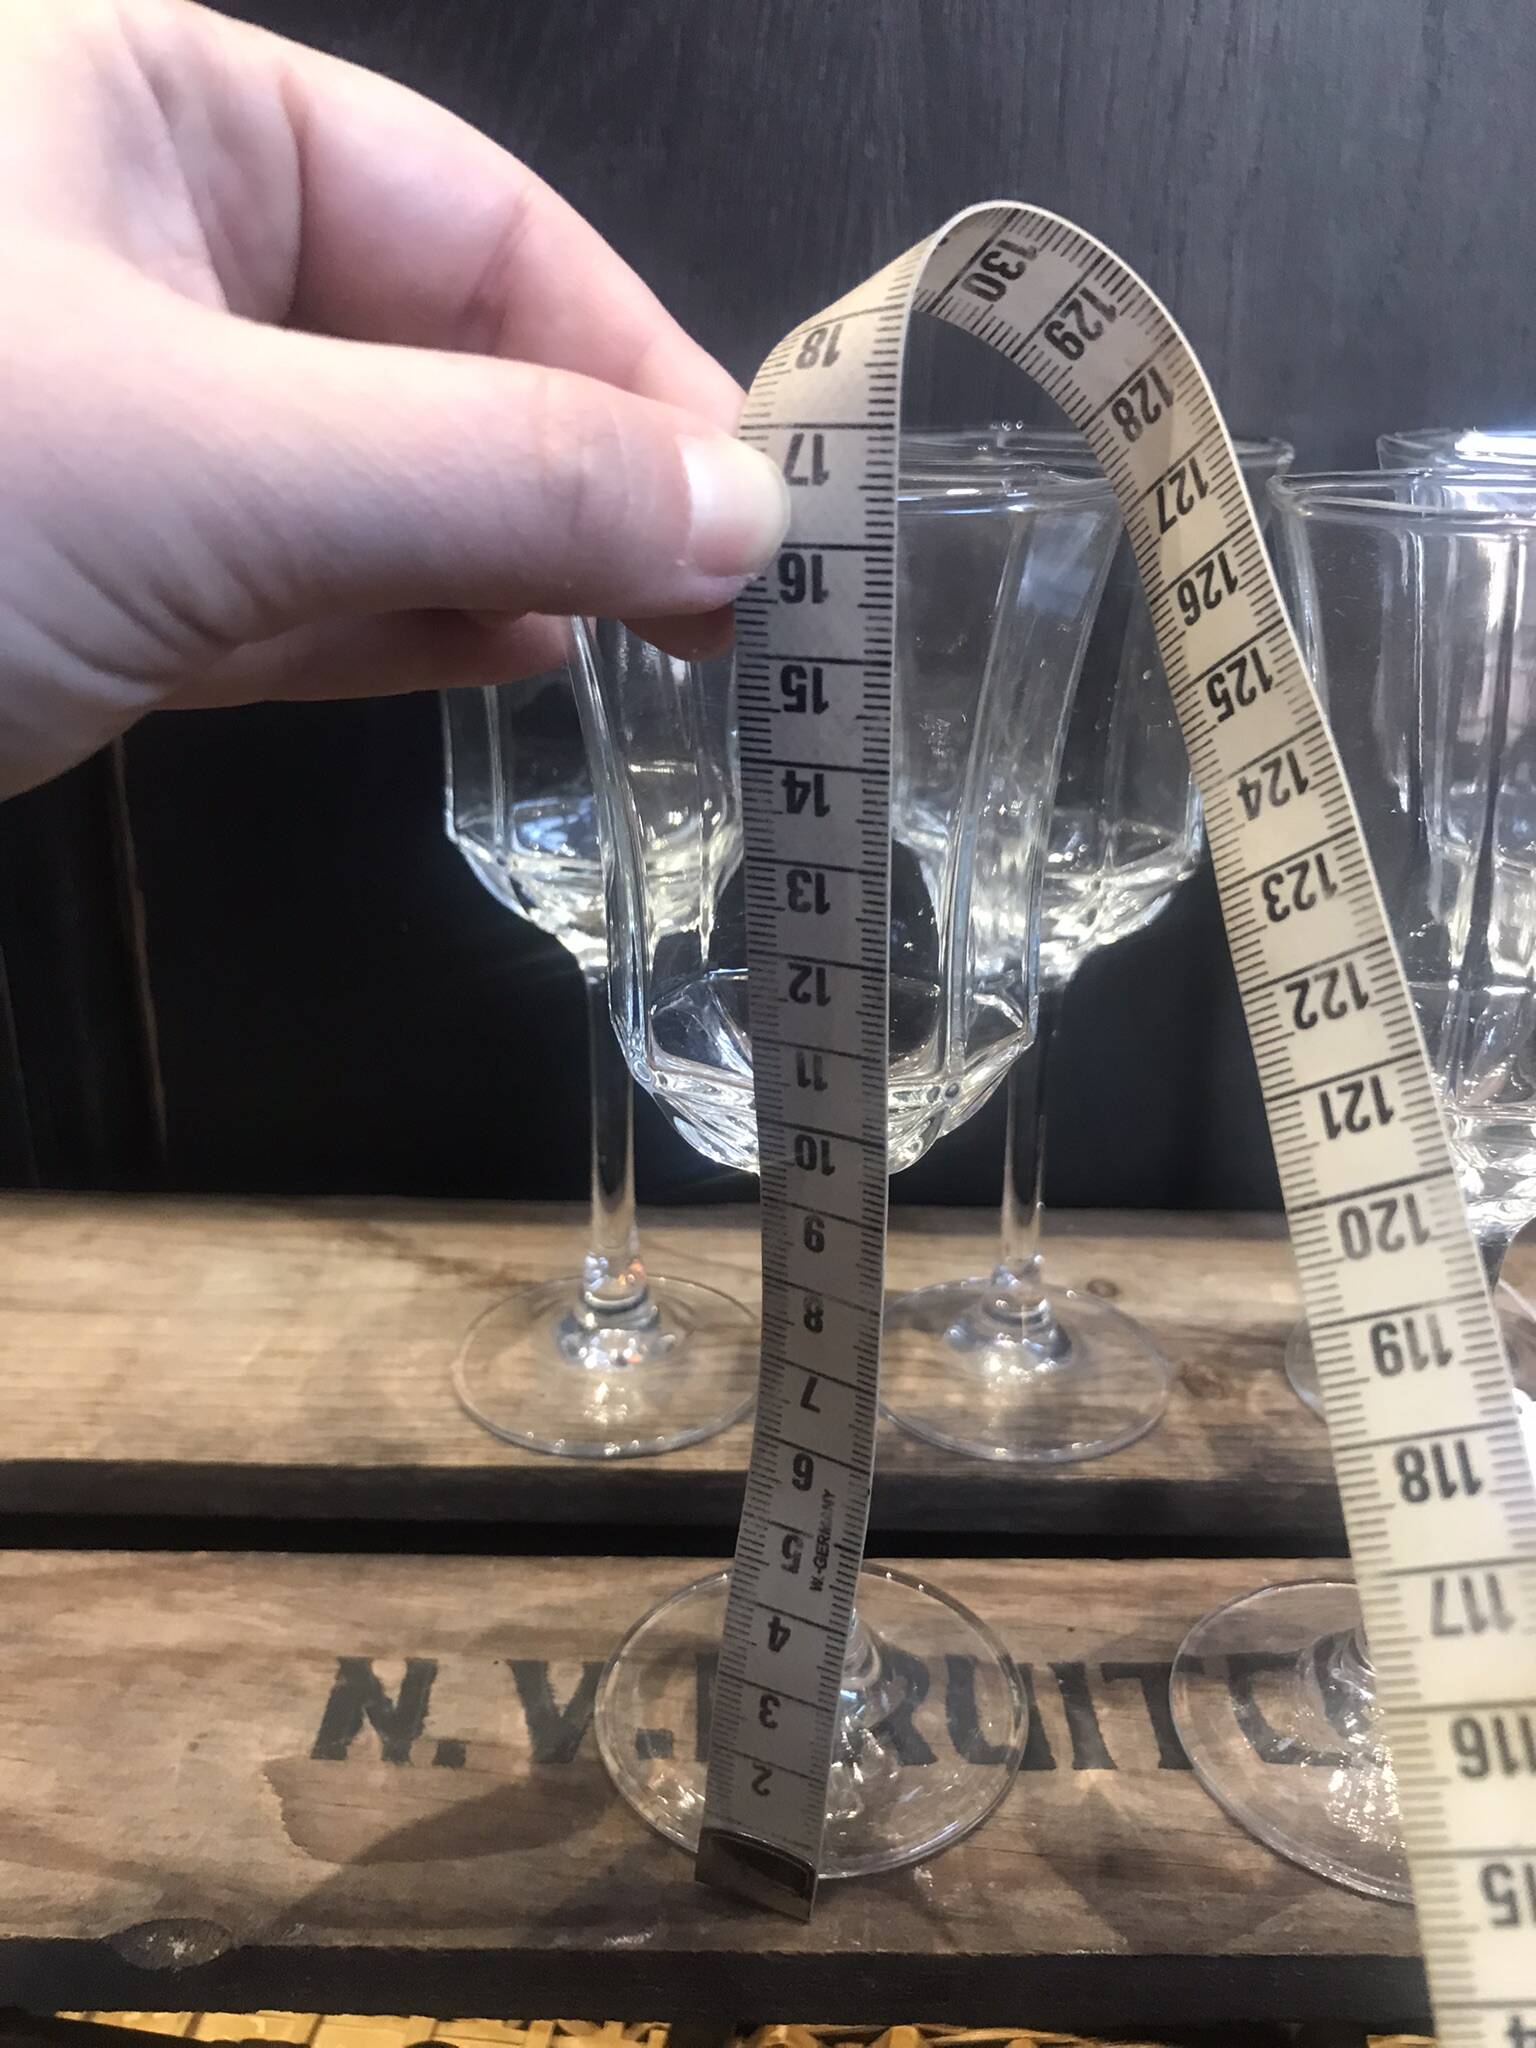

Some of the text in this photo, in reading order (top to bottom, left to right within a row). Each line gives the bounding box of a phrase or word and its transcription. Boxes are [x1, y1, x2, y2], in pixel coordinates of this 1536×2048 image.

[961, 240, 1037, 303] 130
[796, 323, 843, 370] 18
[1044, 289, 1117, 361] 129
[1111, 366, 1174, 442] 128
[783, 433, 829, 486] 17
[1157, 457, 1210, 534] 127
[778, 553, 829, 604] 16
[1178, 552, 1239, 626] 126
[781, 665, 829, 715] 15
[1206, 647, 1273, 723] 125
[781, 770, 830, 817] 14
[1238, 749, 1309, 821] 124
[785, 869, 830, 915] 13
[1262, 853, 1338, 924] 123
[788, 962, 831, 1007] 12
[1286, 961, 1370, 1031] 122
[796, 1053, 828, 1092] 11
[1317, 1075, 1394, 1140] 121
[794, 1134, 836, 1177] 10
[803, 1214, 825, 1253] 9
[1338, 1192, 1431, 1261] 120
[803, 1297, 824, 1334] 8
[1369, 1313, 1452, 1378] 119
[800, 1376, 820, 1414] 7
[792, 1453, 815, 1491] 6
[1393, 1439, 1483, 1503] 118
[781, 1534, 803, 1574] 5
[1431, 1573, 1516, 1636] 117
[767, 1615, 791, 1652] 4
[758, 1694, 781, 1729] 3
[752, 1762, 774, 1796] 2
